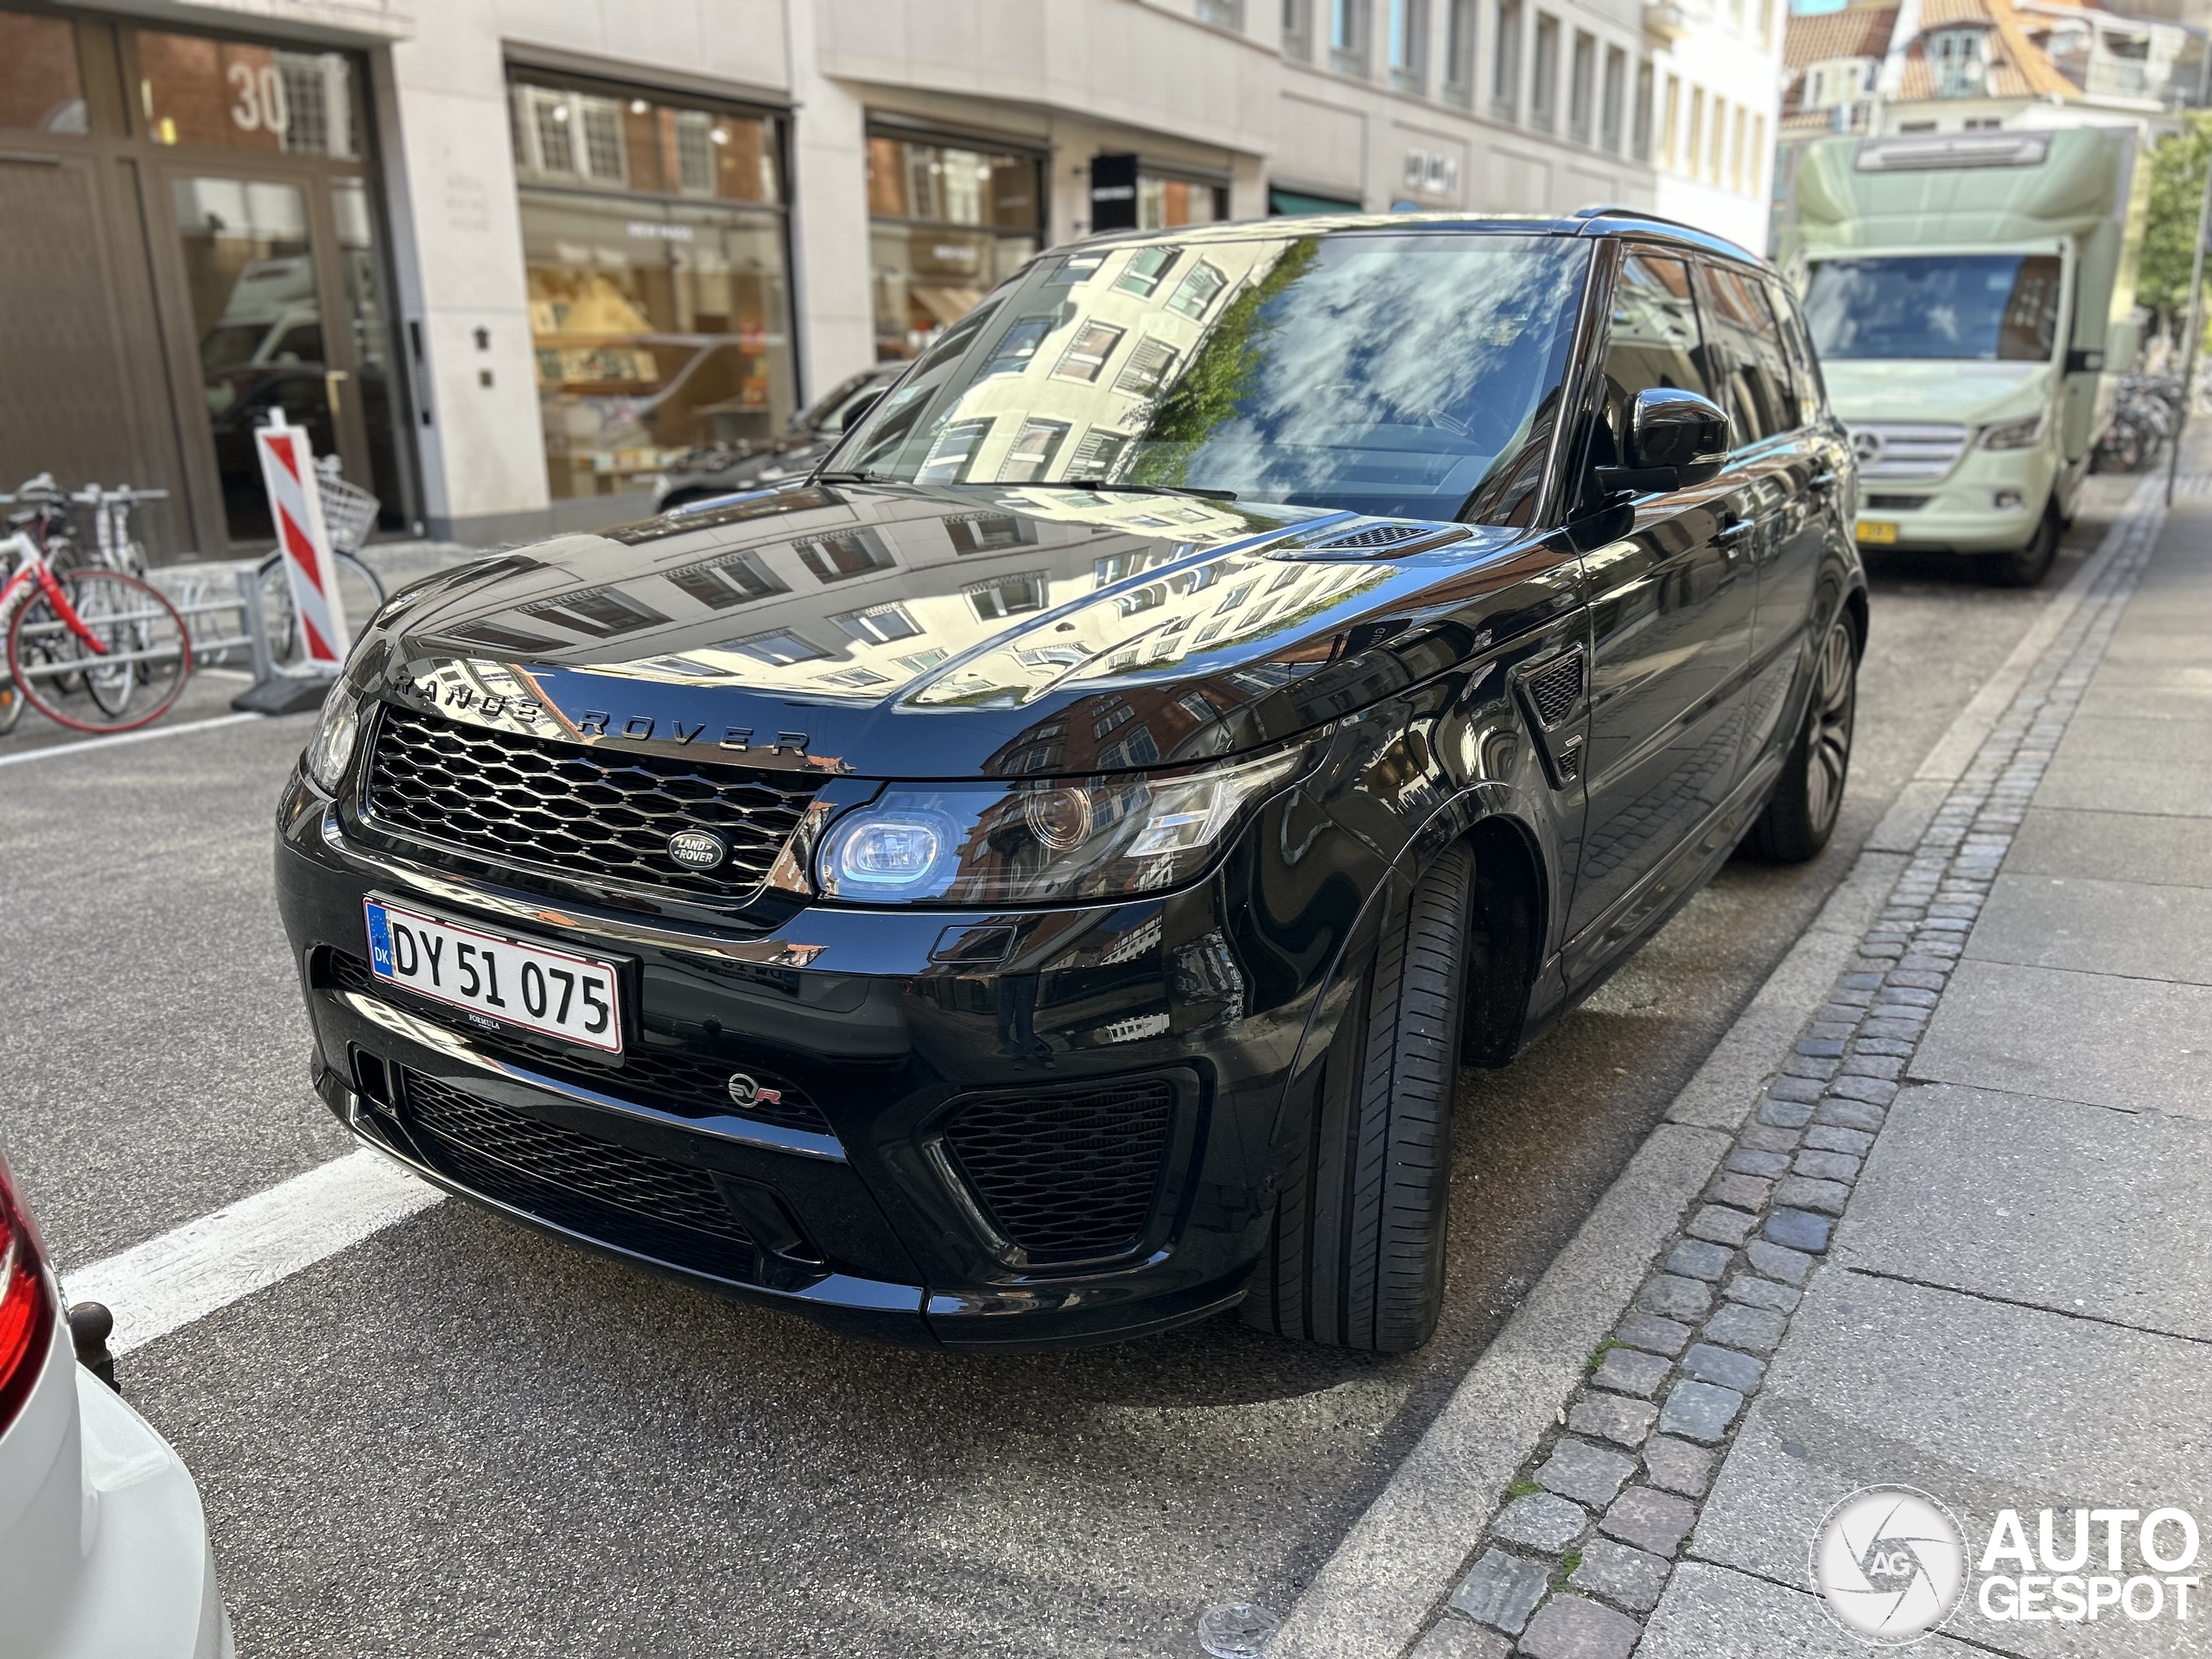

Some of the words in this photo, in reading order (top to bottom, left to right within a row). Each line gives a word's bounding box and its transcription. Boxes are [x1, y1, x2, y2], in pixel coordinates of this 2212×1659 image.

[226, 62, 289, 134] 30
[392, 672, 543, 723] RANGE
[577, 709, 810, 757] ROVER
[677, 837, 706, 851] LAND
[678, 849, 714, 863] ROVER
[374, 945, 390, 966] DK
[392, 921, 444, 988] DY
[456, 941, 506, 1009] 51
[521, 960, 609, 1034] 075
[468, 1014, 501, 1030] FORMULA
[728, 1073, 782, 1109] SVR
